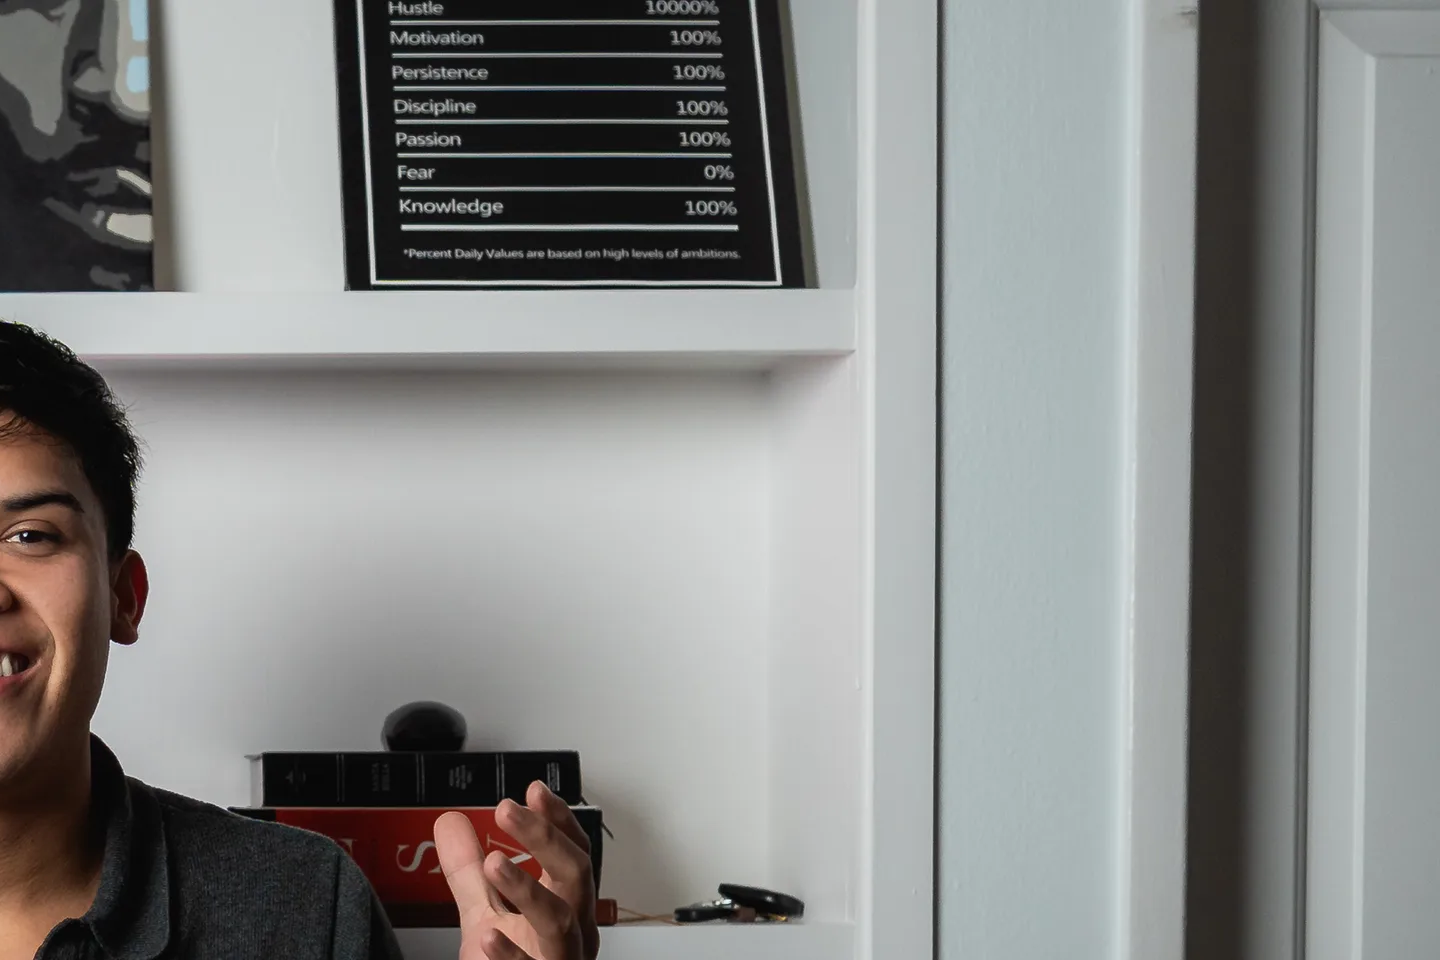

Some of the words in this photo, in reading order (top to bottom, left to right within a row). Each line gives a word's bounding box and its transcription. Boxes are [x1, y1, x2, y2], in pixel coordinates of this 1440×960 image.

[388, 1, 444, 15] Hustle
[646, 0, 719, 14] 10000%
[390, 31, 484, 45] Motivation
[671, 31, 721, 45] 100%
[392, 65, 488, 80] Persistence
[674, 65, 725, 80] 100%
[394, 99, 476, 116] Discipline
[676, 101, 728, 117] 100%
[396, 132, 461, 146] Passion
[680, 132, 731, 146] 100%
[398, 165, 435, 180] Fear
[704, 165, 734, 180] 0%
[399, 199, 503, 217] Knowledge
[686, 201, 737, 215] 100%
[455, 249, 483, 260] Daily
[486, 249, 524, 258] Values
[527, 251, 545, 259] are
[547, 249, 582, 259] based
[603, 248, 629, 261] high
[632, 249, 664, 259] levels
[666, 249, 678, 258] of
[681, 249, 740, 259] ambitions.
